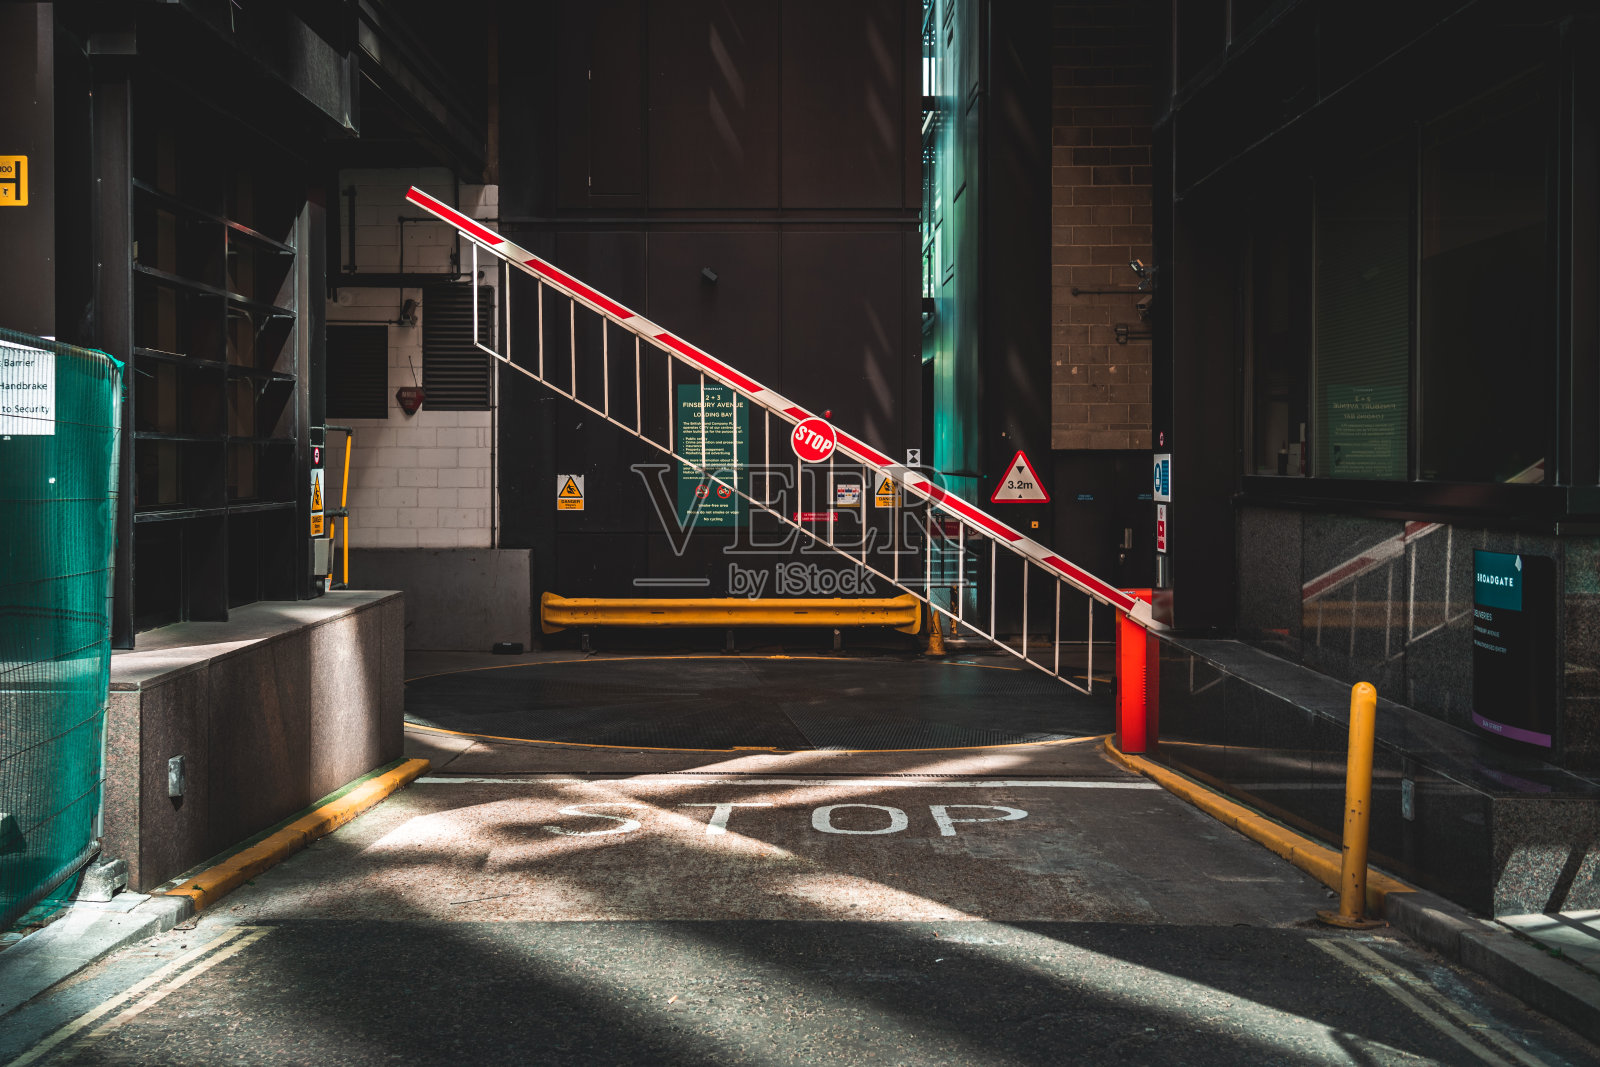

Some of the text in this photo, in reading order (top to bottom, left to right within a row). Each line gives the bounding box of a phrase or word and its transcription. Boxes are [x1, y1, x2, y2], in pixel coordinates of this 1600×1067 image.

[15, 405, 49, 414] Security
[795, 426, 832, 453] STOP
[1008, 481, 1033, 489] 3.2m
[1477, 573, 1514, 587] BROADGATE
[541, 803, 1029, 836] STOP
